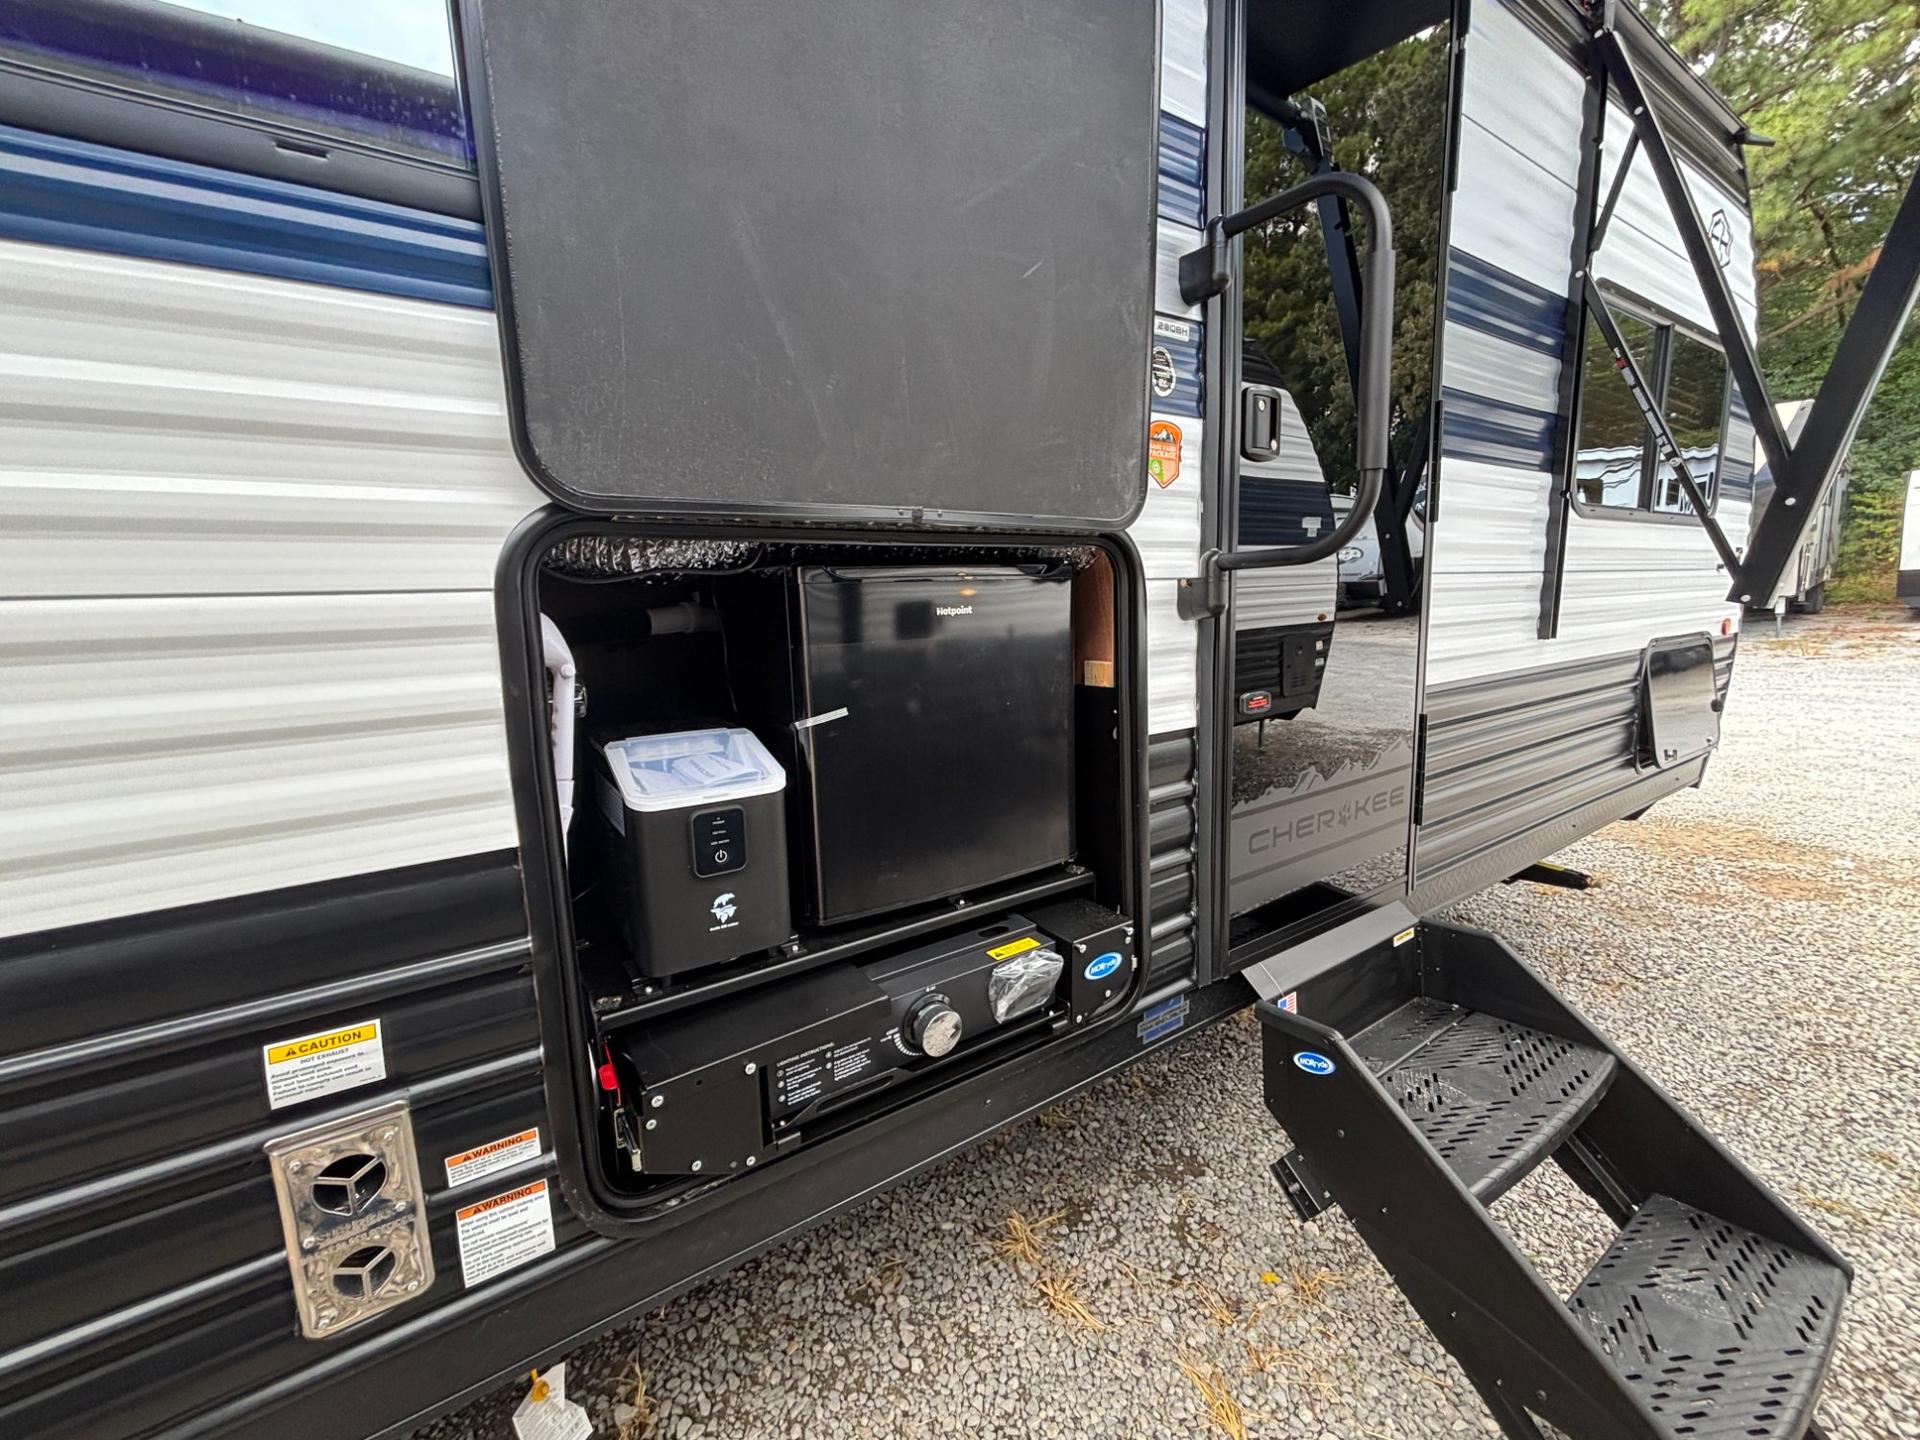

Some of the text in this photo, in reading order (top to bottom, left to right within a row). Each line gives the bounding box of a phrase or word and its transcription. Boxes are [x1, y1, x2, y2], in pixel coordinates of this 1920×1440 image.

[936, 605, 973, 617] Hotpoint
[298, 1030, 361, 1053] CAUTION
[300, 1047, 349, 1064] HOT EXHAUST
[472, 1136, 523, 1158] WARNING
[482, 1187, 532, 1211] WARNING
